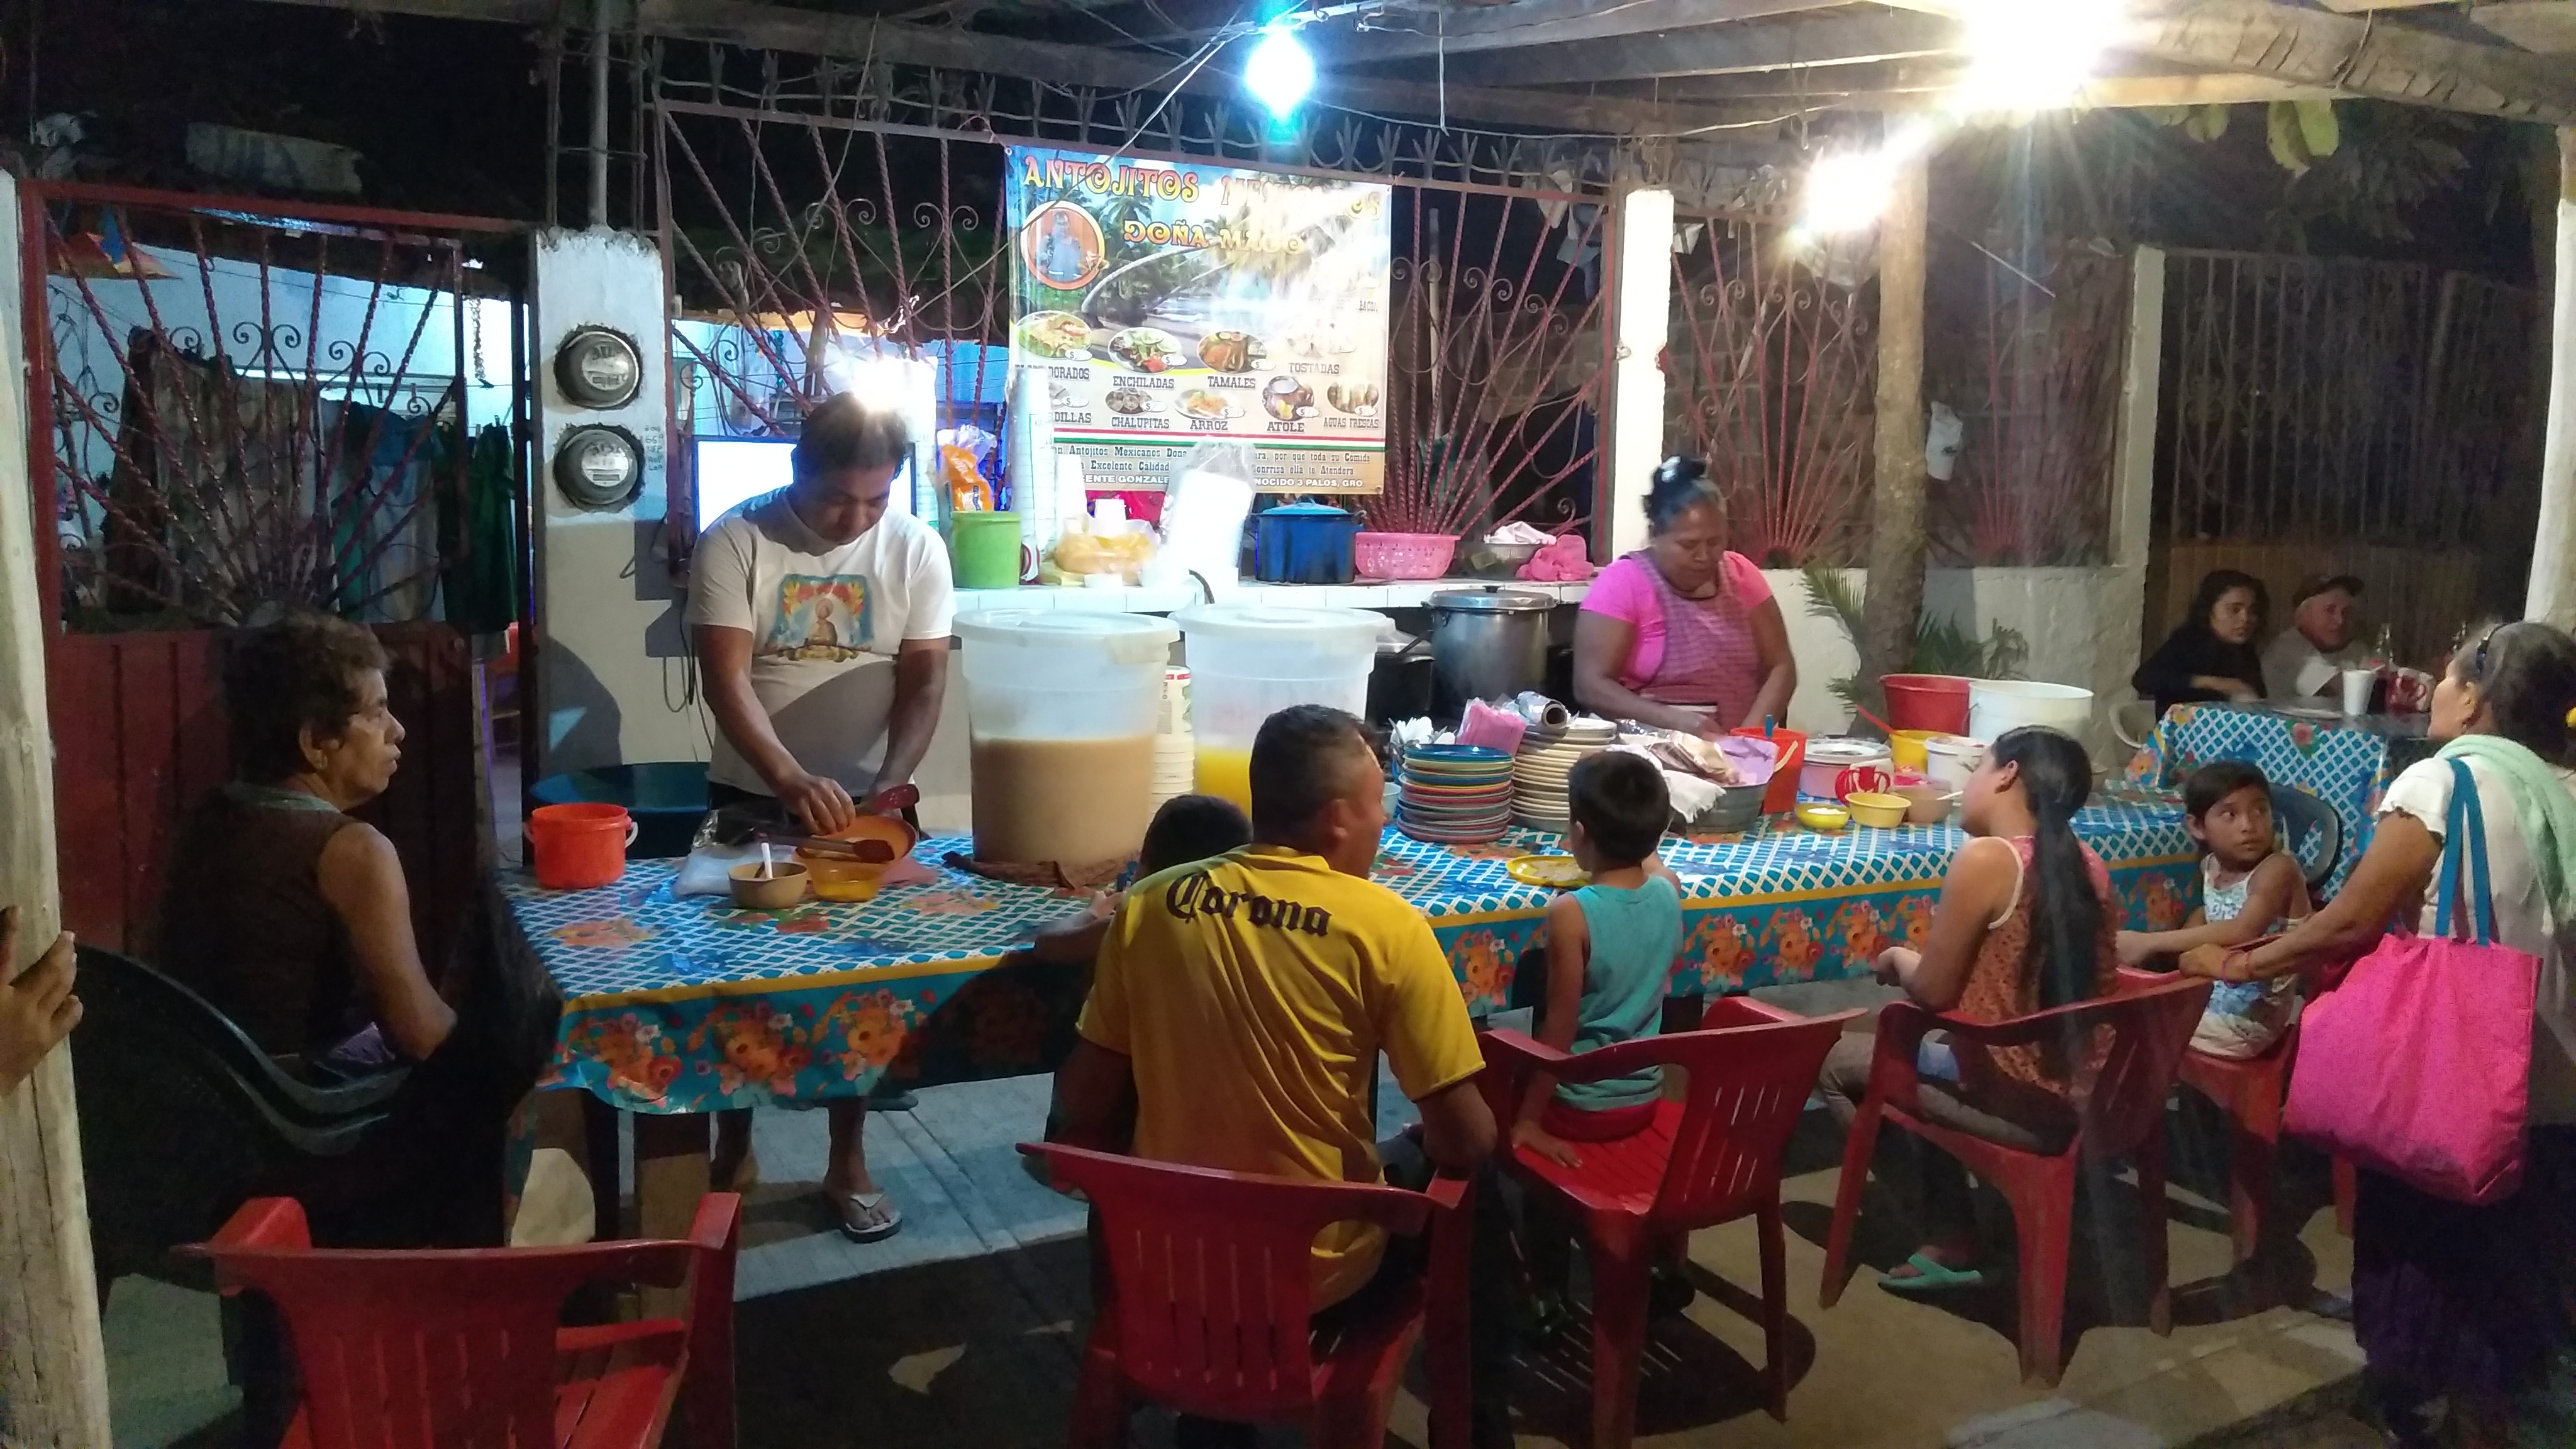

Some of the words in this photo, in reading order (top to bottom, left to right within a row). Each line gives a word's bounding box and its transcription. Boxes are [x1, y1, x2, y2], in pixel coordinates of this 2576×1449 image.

[1024, 155, 1199, 203] ANTOJITOS
[1123, 219, 1209, 249] DOÑA
[1289, 362, 1340, 374] TOSTADAS
[1113, 375, 1175, 389] ENCHILADAS
[1208, 375, 1256, 388] TAMALES
[1054, 411, 1092, 423] DILLAS
[1111, 416, 1170, 429] CHALUPITAS
[1323, 417, 1346, 428] AGUAS
[1190, 419, 1228, 431] ARROZ
[1267, 421, 1305, 432] ATOLE
[1069, 445, 1108, 458] Antojitos
[1114, 447, 1160, 457] Mexicanos
[1274, 453, 1287, 462] por
[1292, 453, 1305, 462] que
[1311, 452, 1326, 461] toda
[1091, 460, 1133, 470] Excelente
[1138, 460, 1169, 471] Calidad
[1290, 465, 1304, 474] ella
[1309, 465, 1316, 474] te
[1321, 465, 1356, 475] Atendera.
[1083, 474, 1116, 483] ENTE
[1118, 475, 1170, 484] GONZALE
[1256, 477, 1295, 486] NOCIDO
[1306, 479, 1340, 487] PALOS,
[1342, 479, 1365, 487] GRO.
[1166, 869, 1332, 937] Corona
